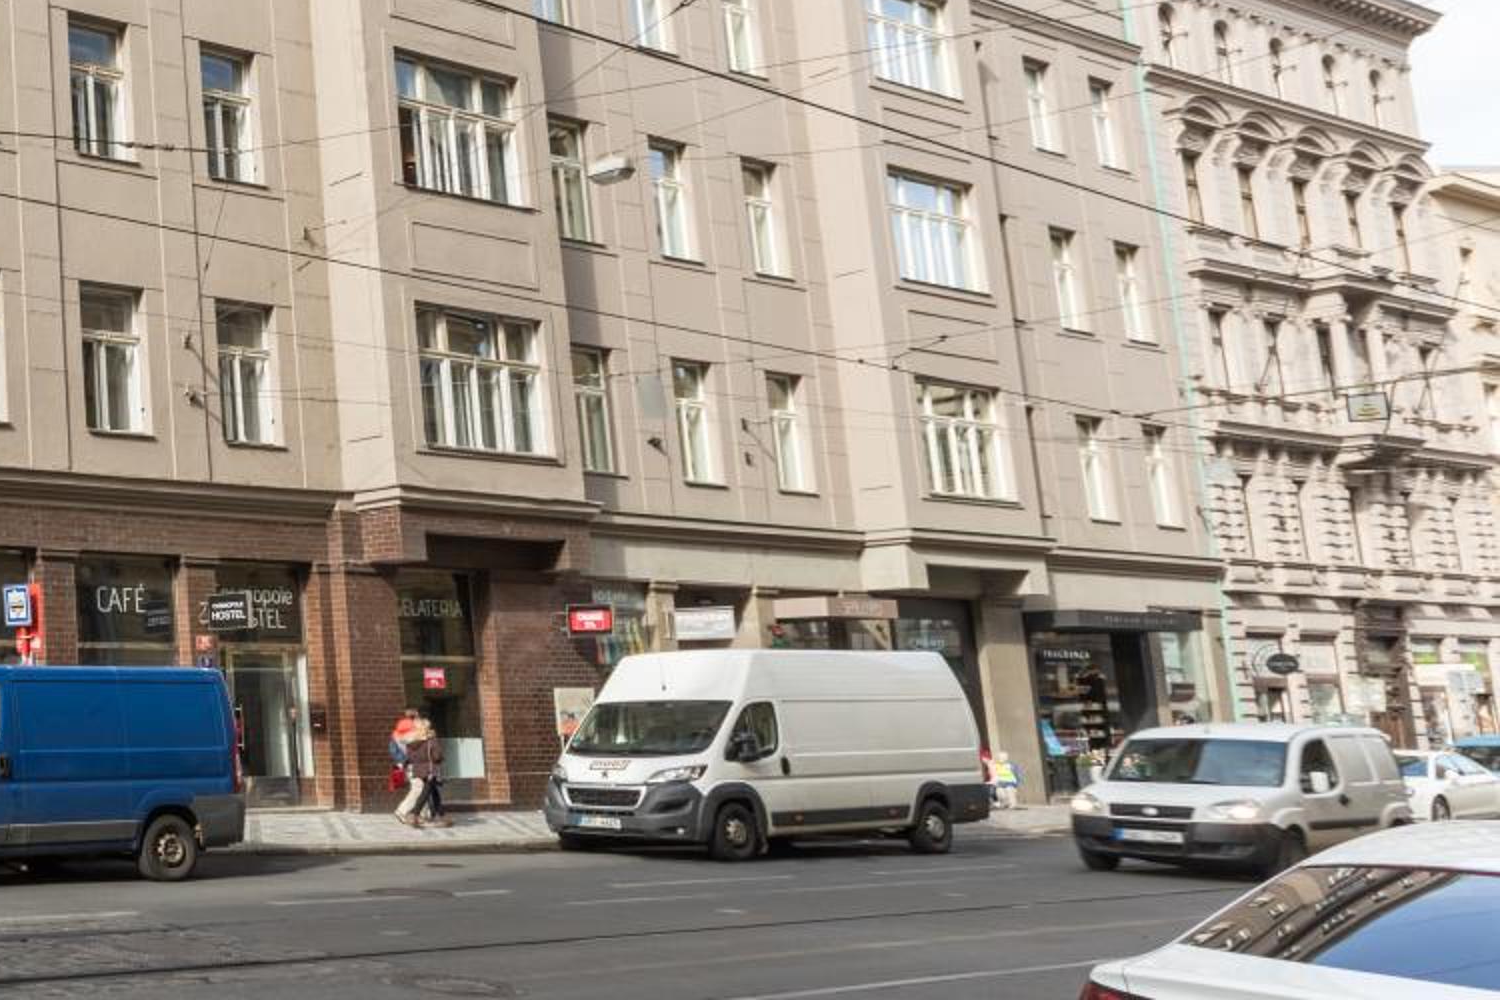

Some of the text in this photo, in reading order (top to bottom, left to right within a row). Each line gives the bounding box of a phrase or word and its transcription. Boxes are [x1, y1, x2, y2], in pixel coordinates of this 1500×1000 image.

[96, 583, 147, 613] CAFÉ
[211, 608, 247, 621] HOSTEL
[401, 599, 463, 617] ELATERIA
